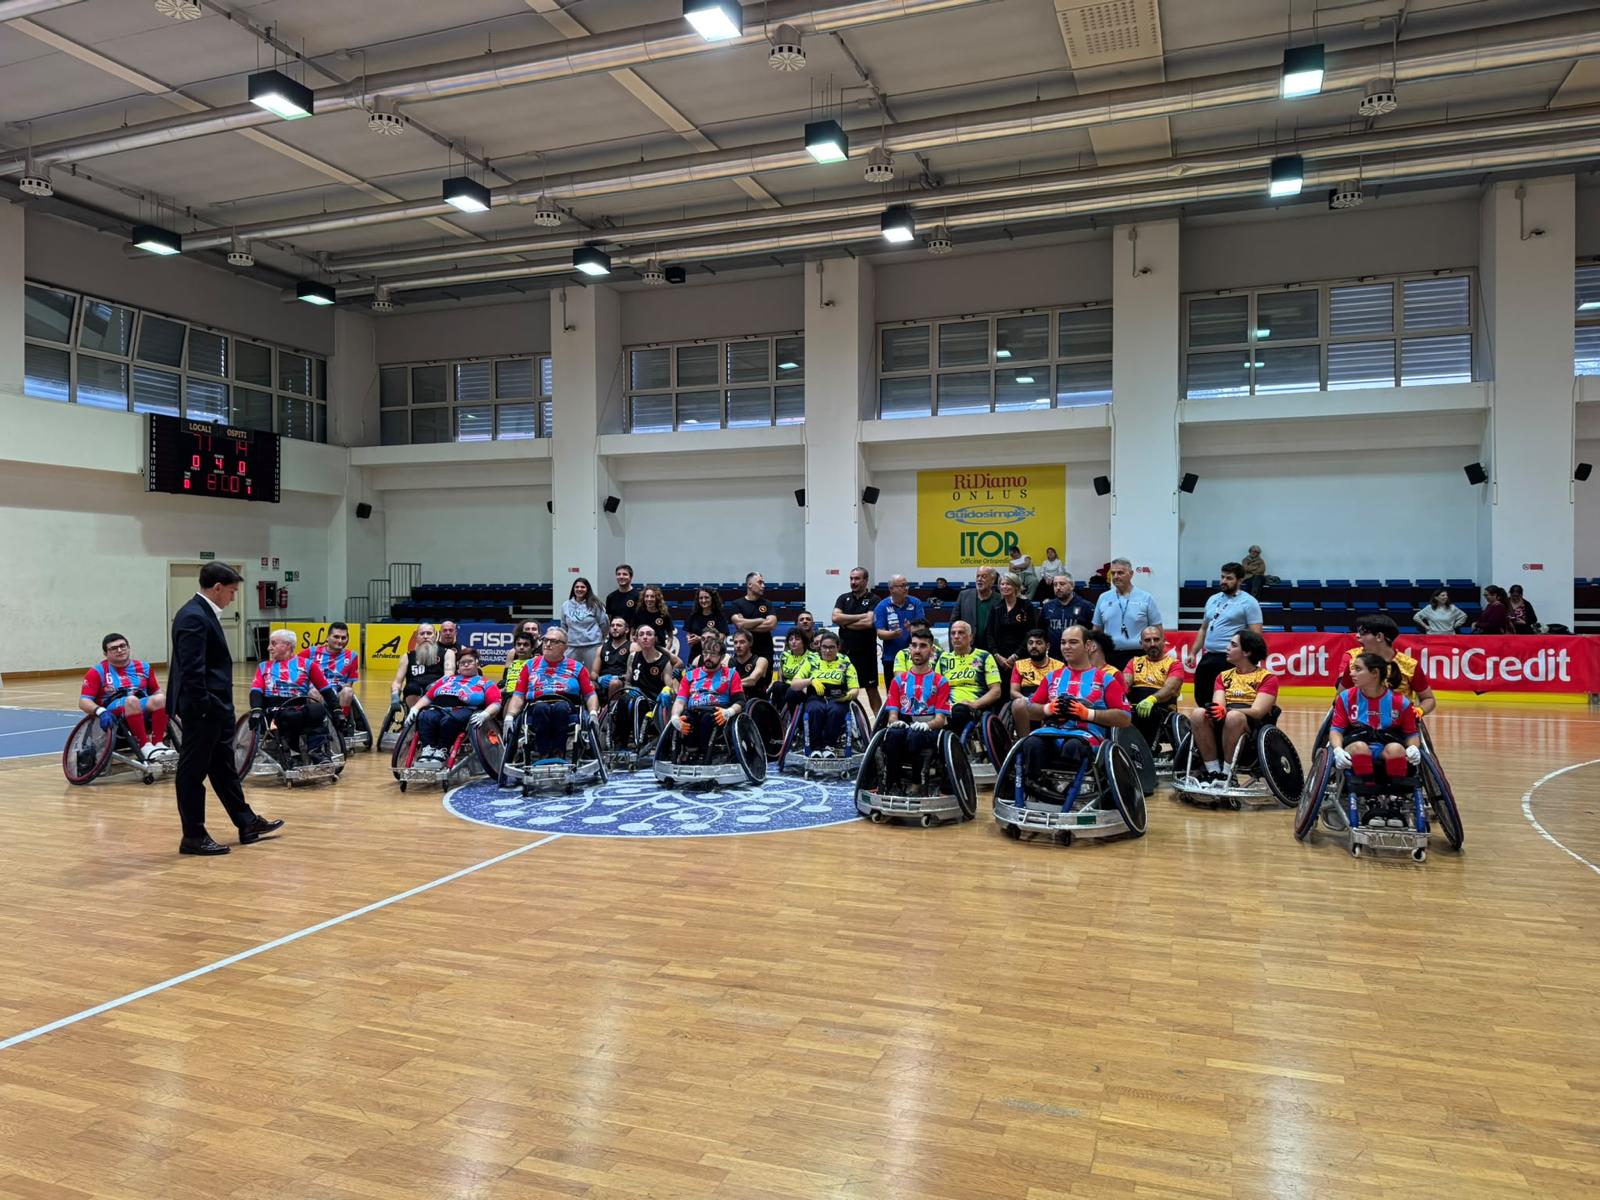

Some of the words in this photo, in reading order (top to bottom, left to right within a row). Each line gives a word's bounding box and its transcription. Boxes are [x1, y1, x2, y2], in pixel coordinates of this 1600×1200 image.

[189, 423, 212, 433] LOCALI
[227, 429, 247, 439] OSPITI
[192, 455, 200, 467] 0
[215, 458, 223, 469] 4
[239, 461, 246, 473] 0
[954, 473, 1028, 489] RiDiamo
[952, 489, 1028, 501] ONLUS
[411, 664, 426, 676] 50
[633, 669, 640, 681] 3
[817, 670, 842, 680] zelo
[950, 666, 977, 681] zelo
[106, 672, 113, 685] 6
[1053, 677, 1061, 689] 9
[1350, 704, 1359, 720] 3
